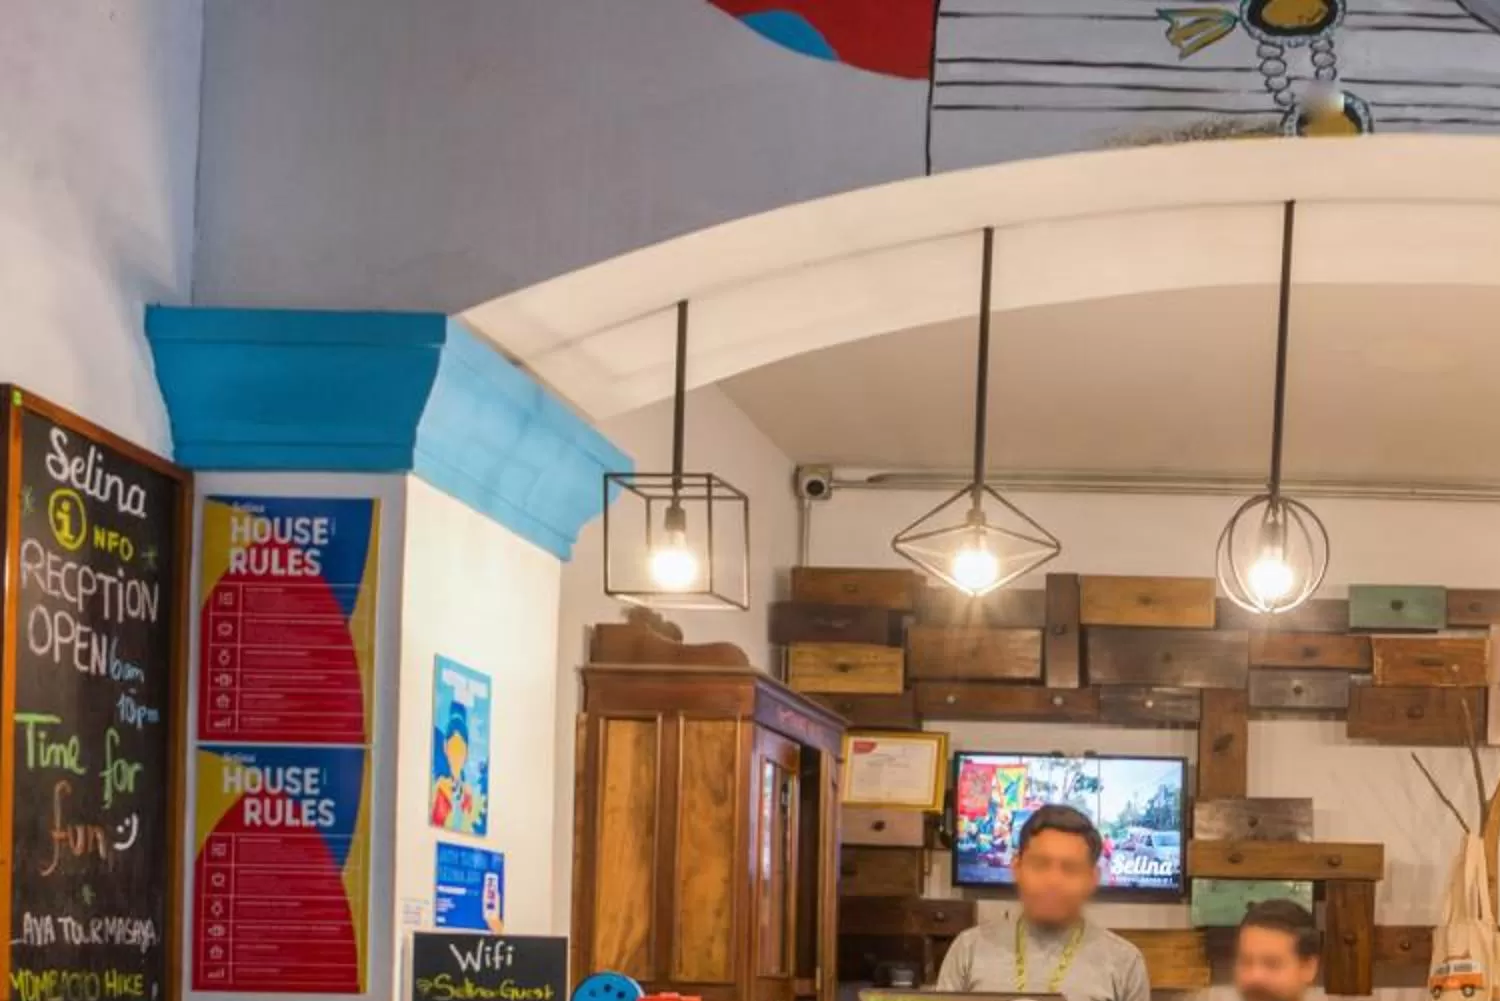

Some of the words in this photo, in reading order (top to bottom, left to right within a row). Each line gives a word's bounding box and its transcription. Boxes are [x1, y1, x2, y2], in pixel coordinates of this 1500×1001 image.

[45, 426, 147, 518] Selina
[230, 515, 329, 545] HOUSE
[229, 547, 322, 576] RULES
[27, 603, 108, 676] OPEN
[14, 712, 87, 775] Time
[99, 727, 143, 810] for
[223, 766, 320, 795] HOUSE
[243, 798, 335, 827] RULES
[1111, 853, 1174, 875] Selina
[449, 938, 515, 972] Wifi
